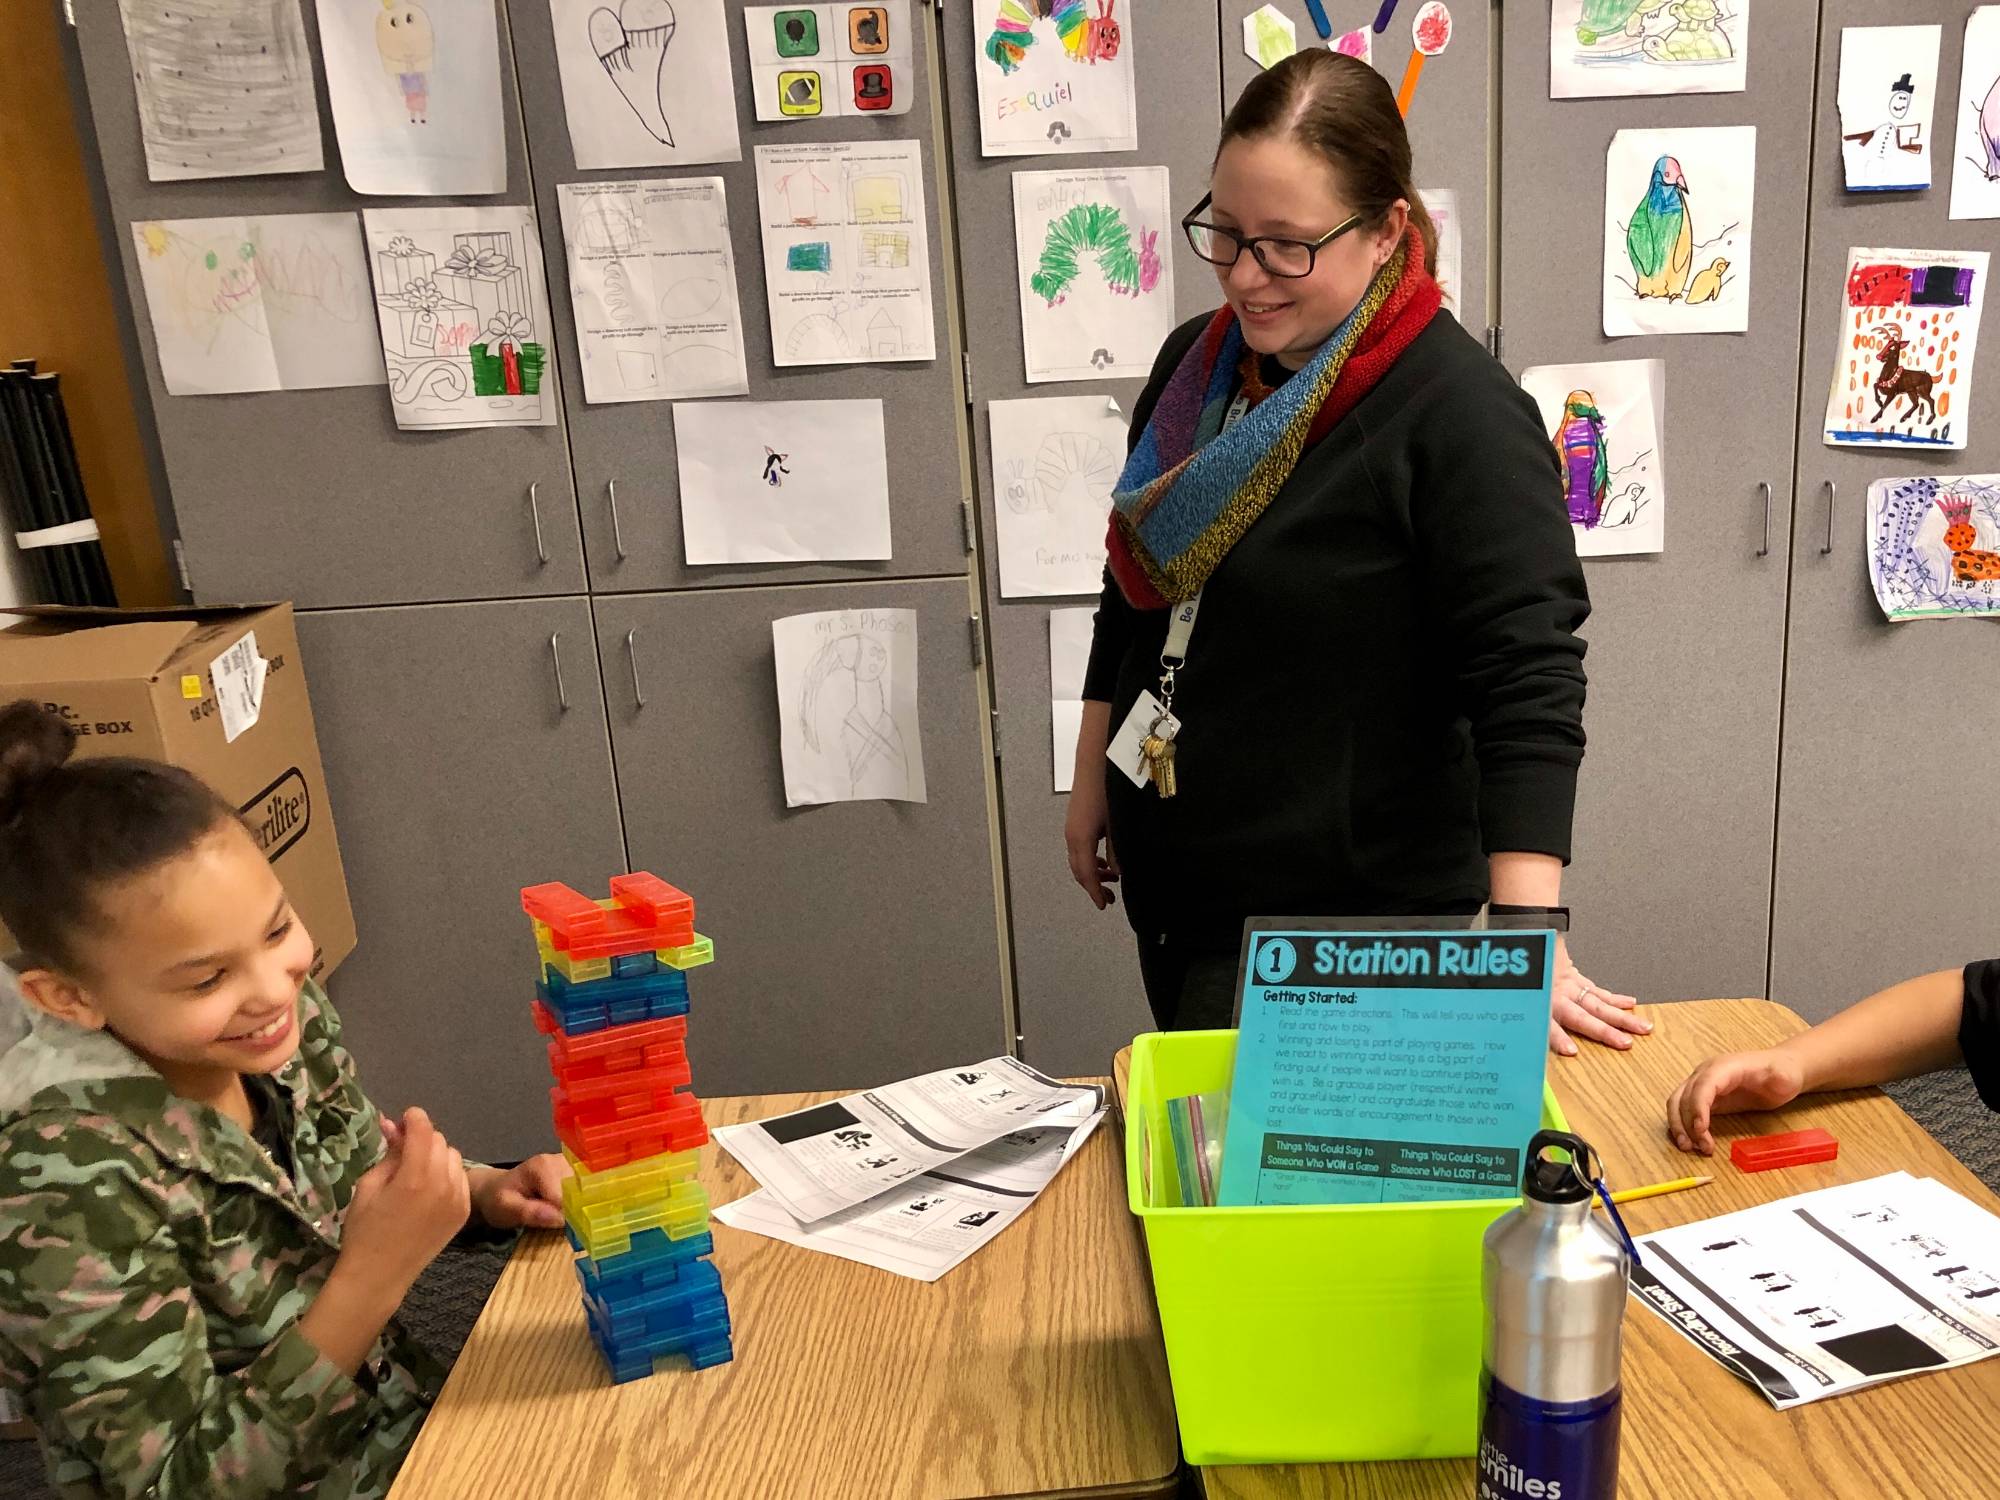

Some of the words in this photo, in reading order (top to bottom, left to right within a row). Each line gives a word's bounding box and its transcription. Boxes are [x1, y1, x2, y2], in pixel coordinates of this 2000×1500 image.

[1179, 606, 1194, 623] Be
[95, 720, 134, 735] BOX
[1313, 940, 1431, 975] Station
[1438, 940, 1530, 976] Rules
[1263, 990, 1306, 1006] Getting
[1308, 991, 1358, 1004] Started:
[1276, 1140, 1302, 1153] Things
[1304, 1142, 1320, 1152] You
[1320, 1143, 1344, 1154] Could
[1346, 1144, 1362, 1158] Say
[1364, 1146, 1374, 1156] to
[1400, 1148, 1429, 1162] Things
[1432, 1150, 1448, 1161] You
[1448, 1151, 1474, 1162] Could
[1476, 1153, 1494, 1167] Say
[1496, 1154, 1505, 1166] to
[1266, 1154, 1304, 1166] Someone
[1306, 1157, 1324, 1168] Who
[1326, 1158, 1346, 1170] WON
[1348, 1162, 1354, 1170] a
[1356, 1161, 1380, 1172] Game
[1390, 1164, 1430, 1176] Someone
[1432, 1166, 1452, 1178] Who
[1454, 1168, 1476, 1180] LOST
[1478, 1171, 1485, 1180] a
[1486, 1170, 1512, 1182] Game
[1644, 1284, 1683, 1314] Sheet
[1676, 1309, 1741, 1356] Recording
[1480, 1448, 1562, 1500] smiles
